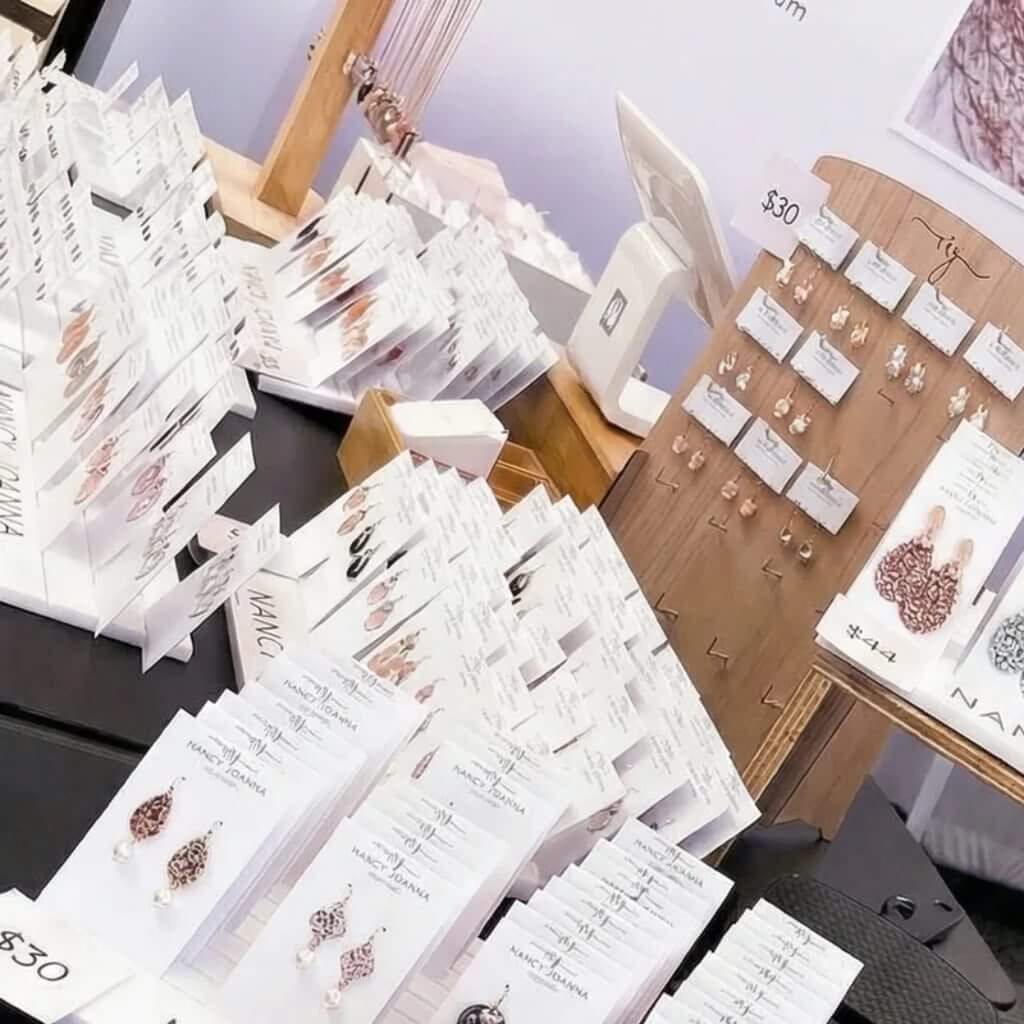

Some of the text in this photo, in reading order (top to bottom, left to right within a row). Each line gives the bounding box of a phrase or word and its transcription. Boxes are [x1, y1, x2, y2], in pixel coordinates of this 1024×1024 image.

[761, 190, 800, 226] $30
[247, 588, 284, 658] NANC
[846, 623, 897, 664] $44
[0, 930, 69, 982] $30
